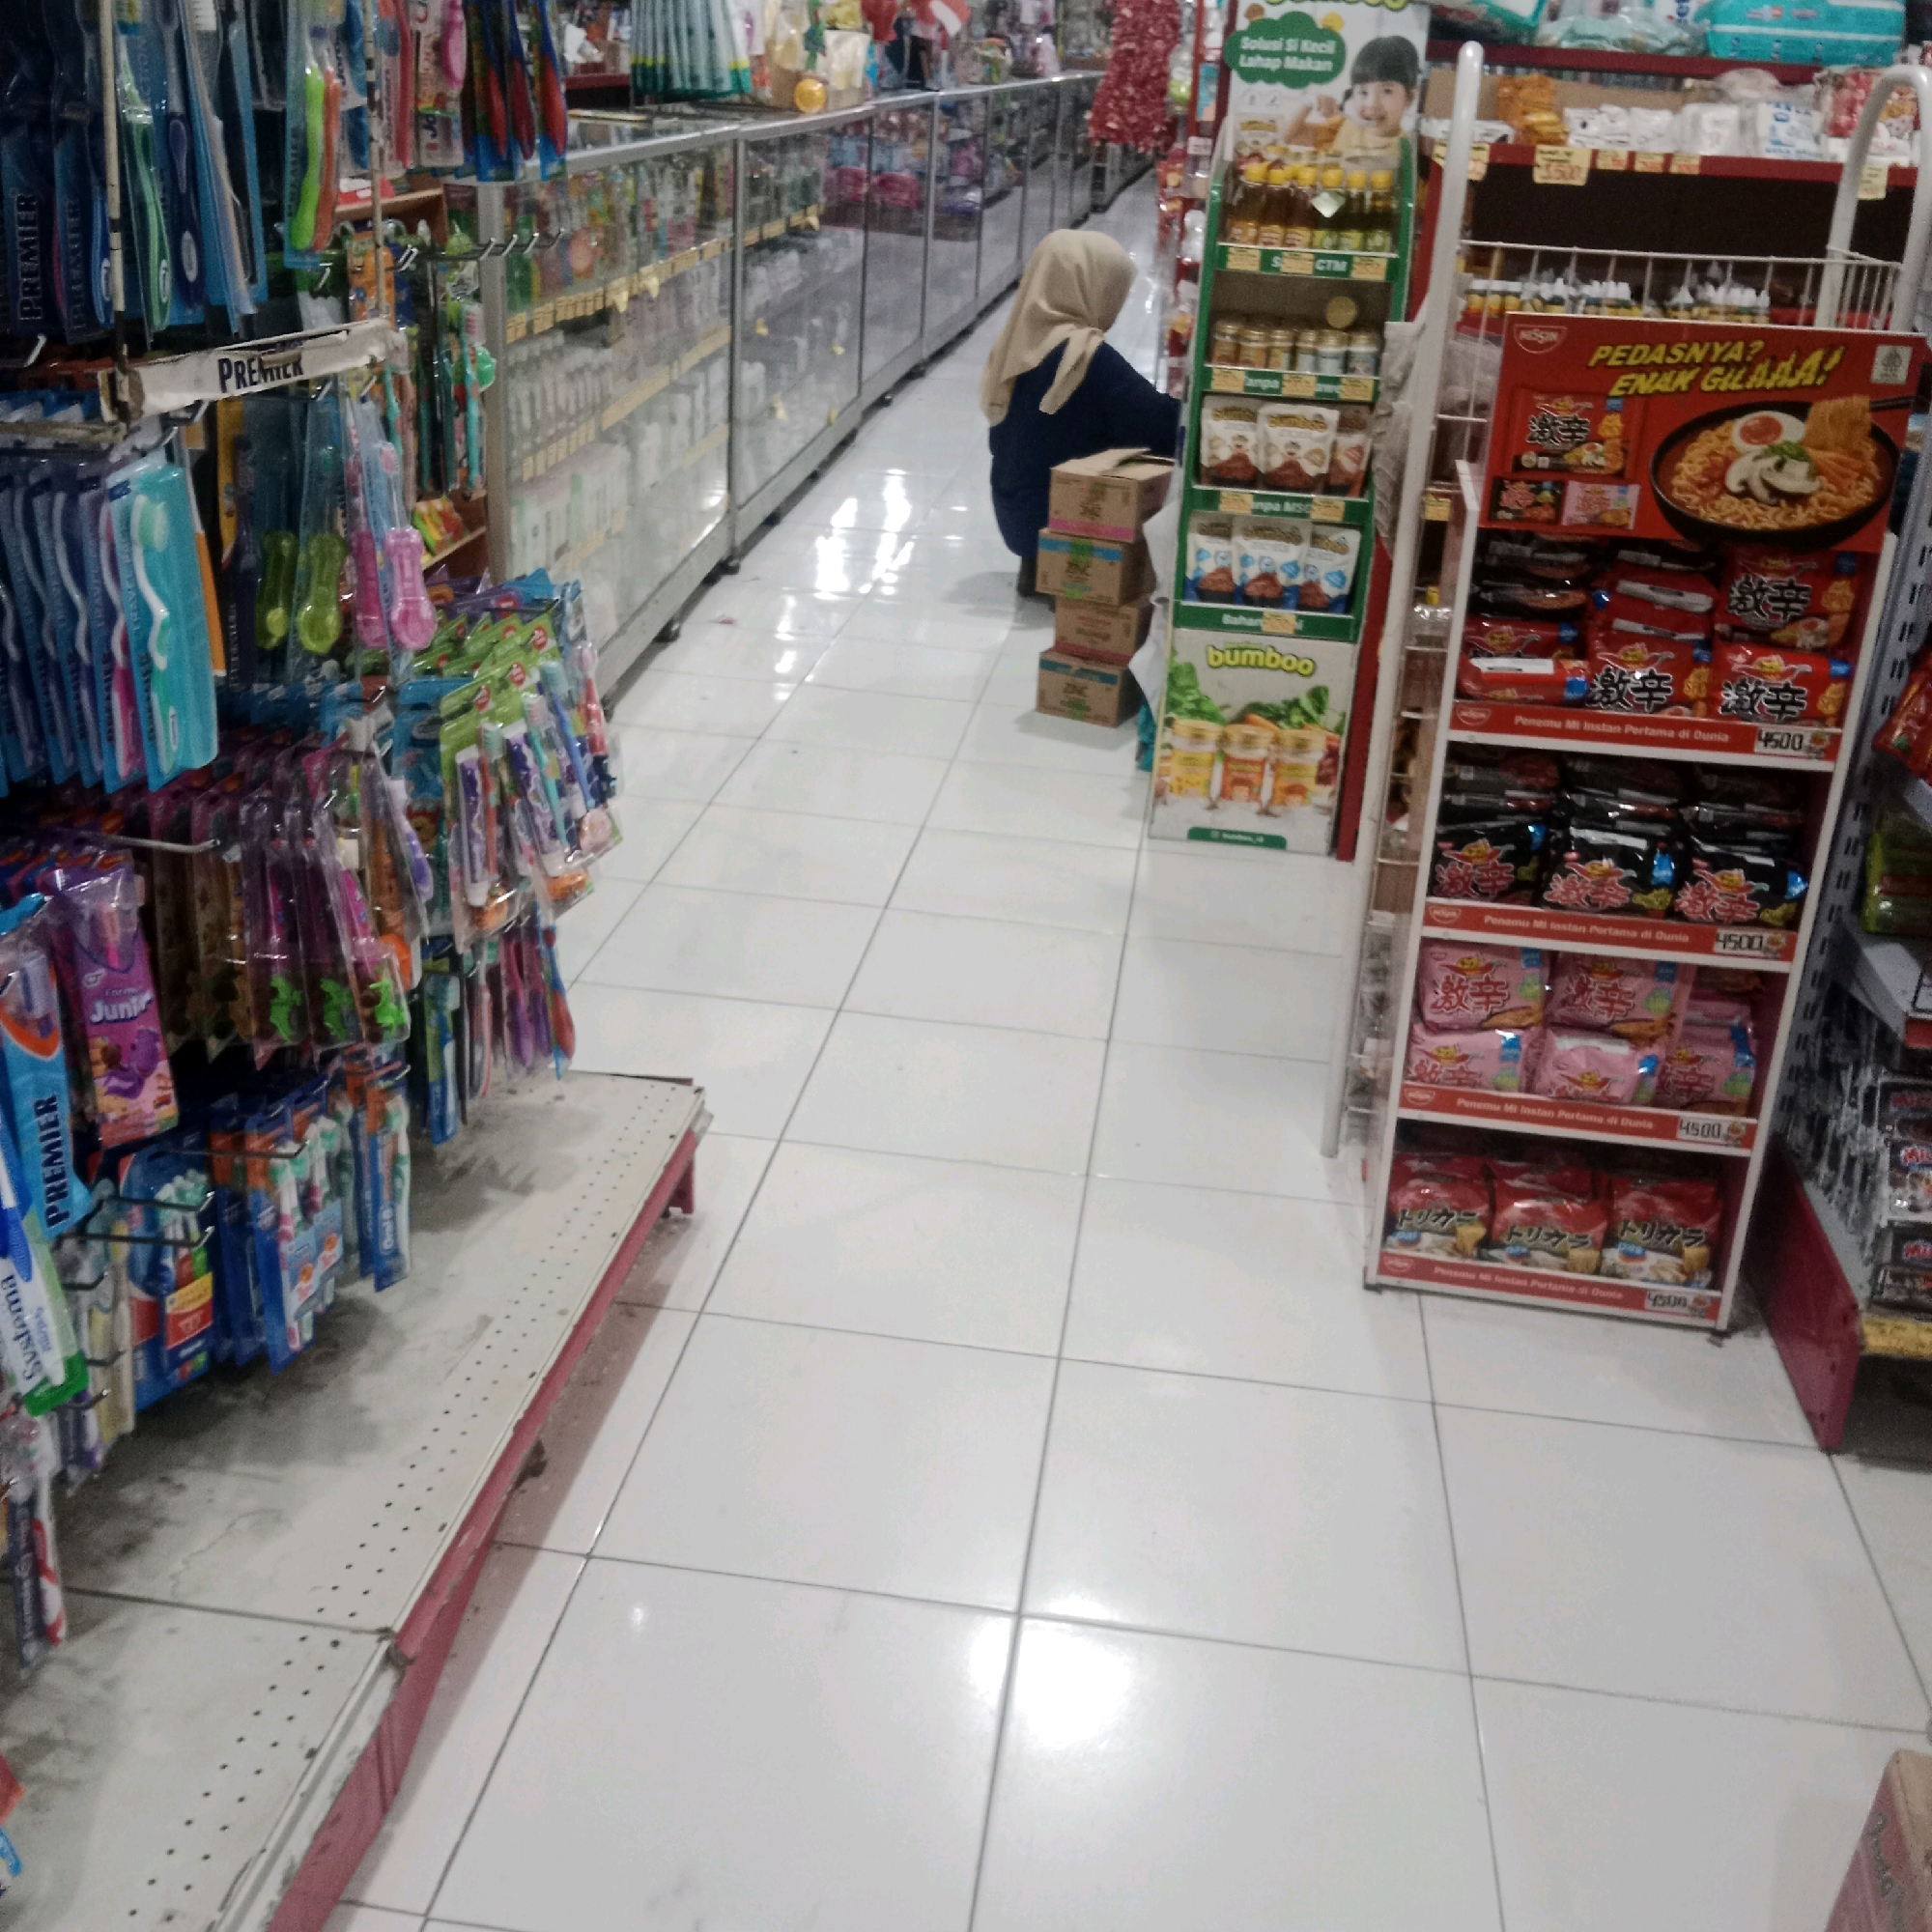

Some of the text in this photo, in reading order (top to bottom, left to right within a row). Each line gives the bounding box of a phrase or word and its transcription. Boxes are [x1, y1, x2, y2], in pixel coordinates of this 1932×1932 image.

[1240, 37, 1336, 54] Solusi Si Kecil
[1239, 55, 1333, 71] Lahap Makan
[17, 192, 43, 321] PREMIER
[1587, 339, 1766, 368] PEDASNYA?
[1607, 366, 1701, 397] ENAK
[1727, 573, 1813, 621] 激辛
[1208, 644, 1316, 676] bumboo
[1586, 667, 1674, 713] 激辛
[1719, 680, 1808, 721] 激辛
[1581, 720, 1622, 734] Instan
[1623, 724, 1676, 739] Pertama
[1677, 727, 1690, 739] di
[1692, 729, 1730, 743] Dunia
[1757, 728, 1804, 751] 4500
[1434, 860, 1515, 899] 激辛
[1548, 919, 1586, 934] Instan
[1588, 924, 1638, 939] Pertama
[1640, 928, 1653, 940] di
[1655, 930, 1690, 943] Dunia
[1716, 931, 1764, 952] 4500
[1556, 1108, 1605, 1123] Pertama
[1620, 1116, 1654, 1130] Dunia
[1679, 1119, 1722, 1140] 4500
[37, 1094, 71, 1229] PREMIER
[1618, 1219, 1709, 1248] トリカラ
